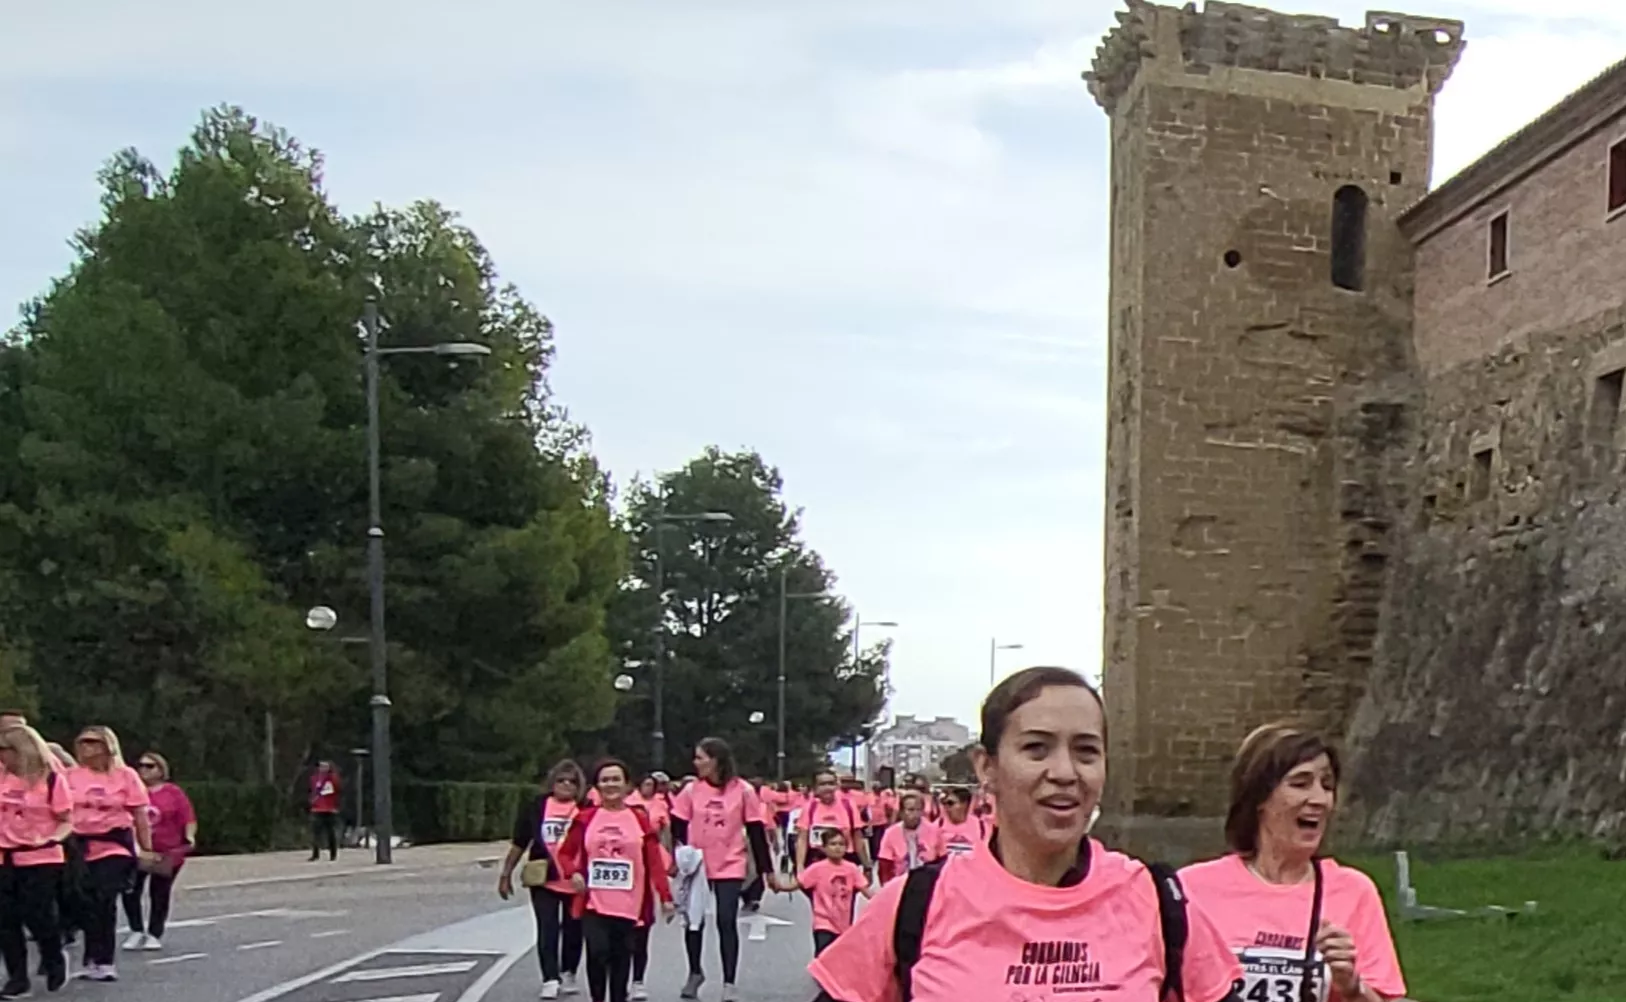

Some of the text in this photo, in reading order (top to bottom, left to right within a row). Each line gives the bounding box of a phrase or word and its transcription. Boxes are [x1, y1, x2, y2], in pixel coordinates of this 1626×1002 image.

[593, 868, 629, 882] 3893
[1005, 961, 1101, 985] POR LA CIENCIA
